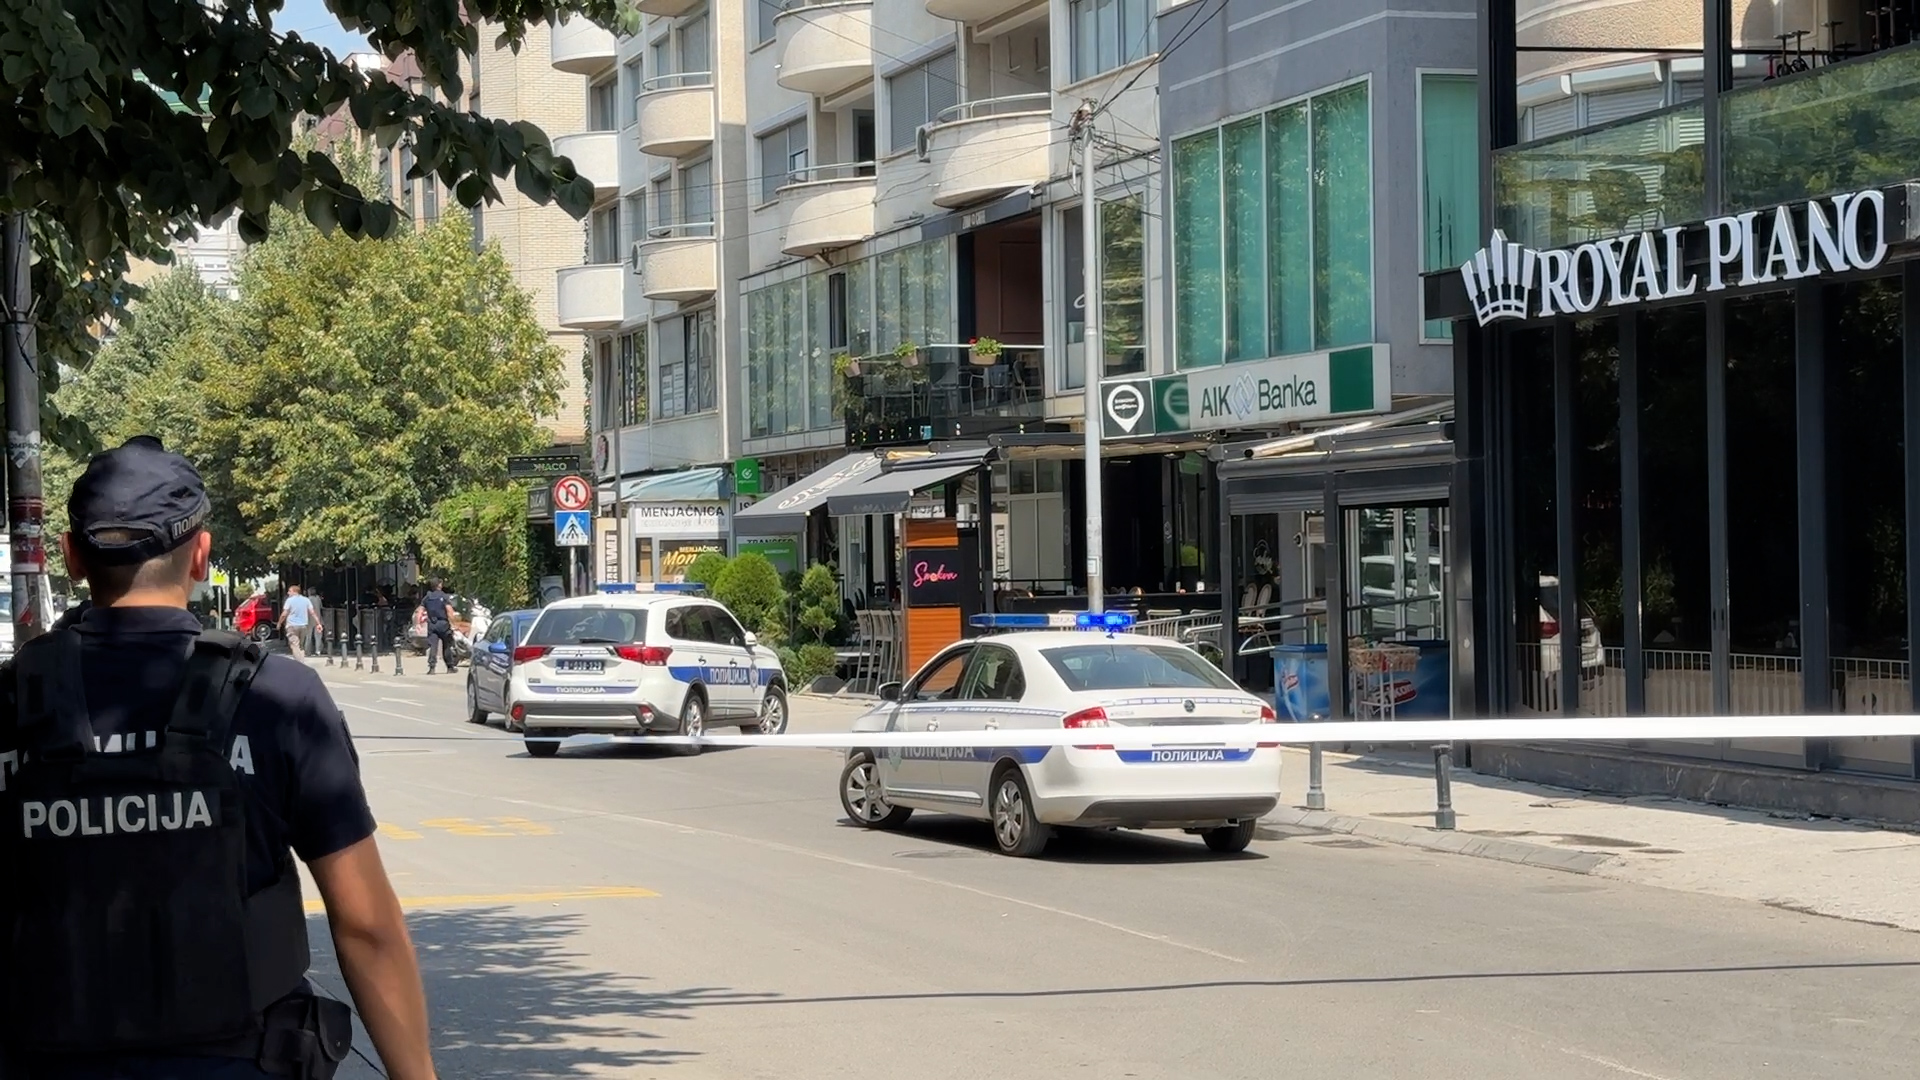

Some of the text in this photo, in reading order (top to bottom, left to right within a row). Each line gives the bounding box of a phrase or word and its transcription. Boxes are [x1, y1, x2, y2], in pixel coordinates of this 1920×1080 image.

[1537, 189, 1889, 317] ROYAL PIANO
[1200, 374, 1317, 418] AIK Banka
[641, 504, 725, 518] MENJAČNICA
[1150, 750, 1225, 763] ПОЛИЦИЈА
[23, 791, 213, 839] POLICIJA
